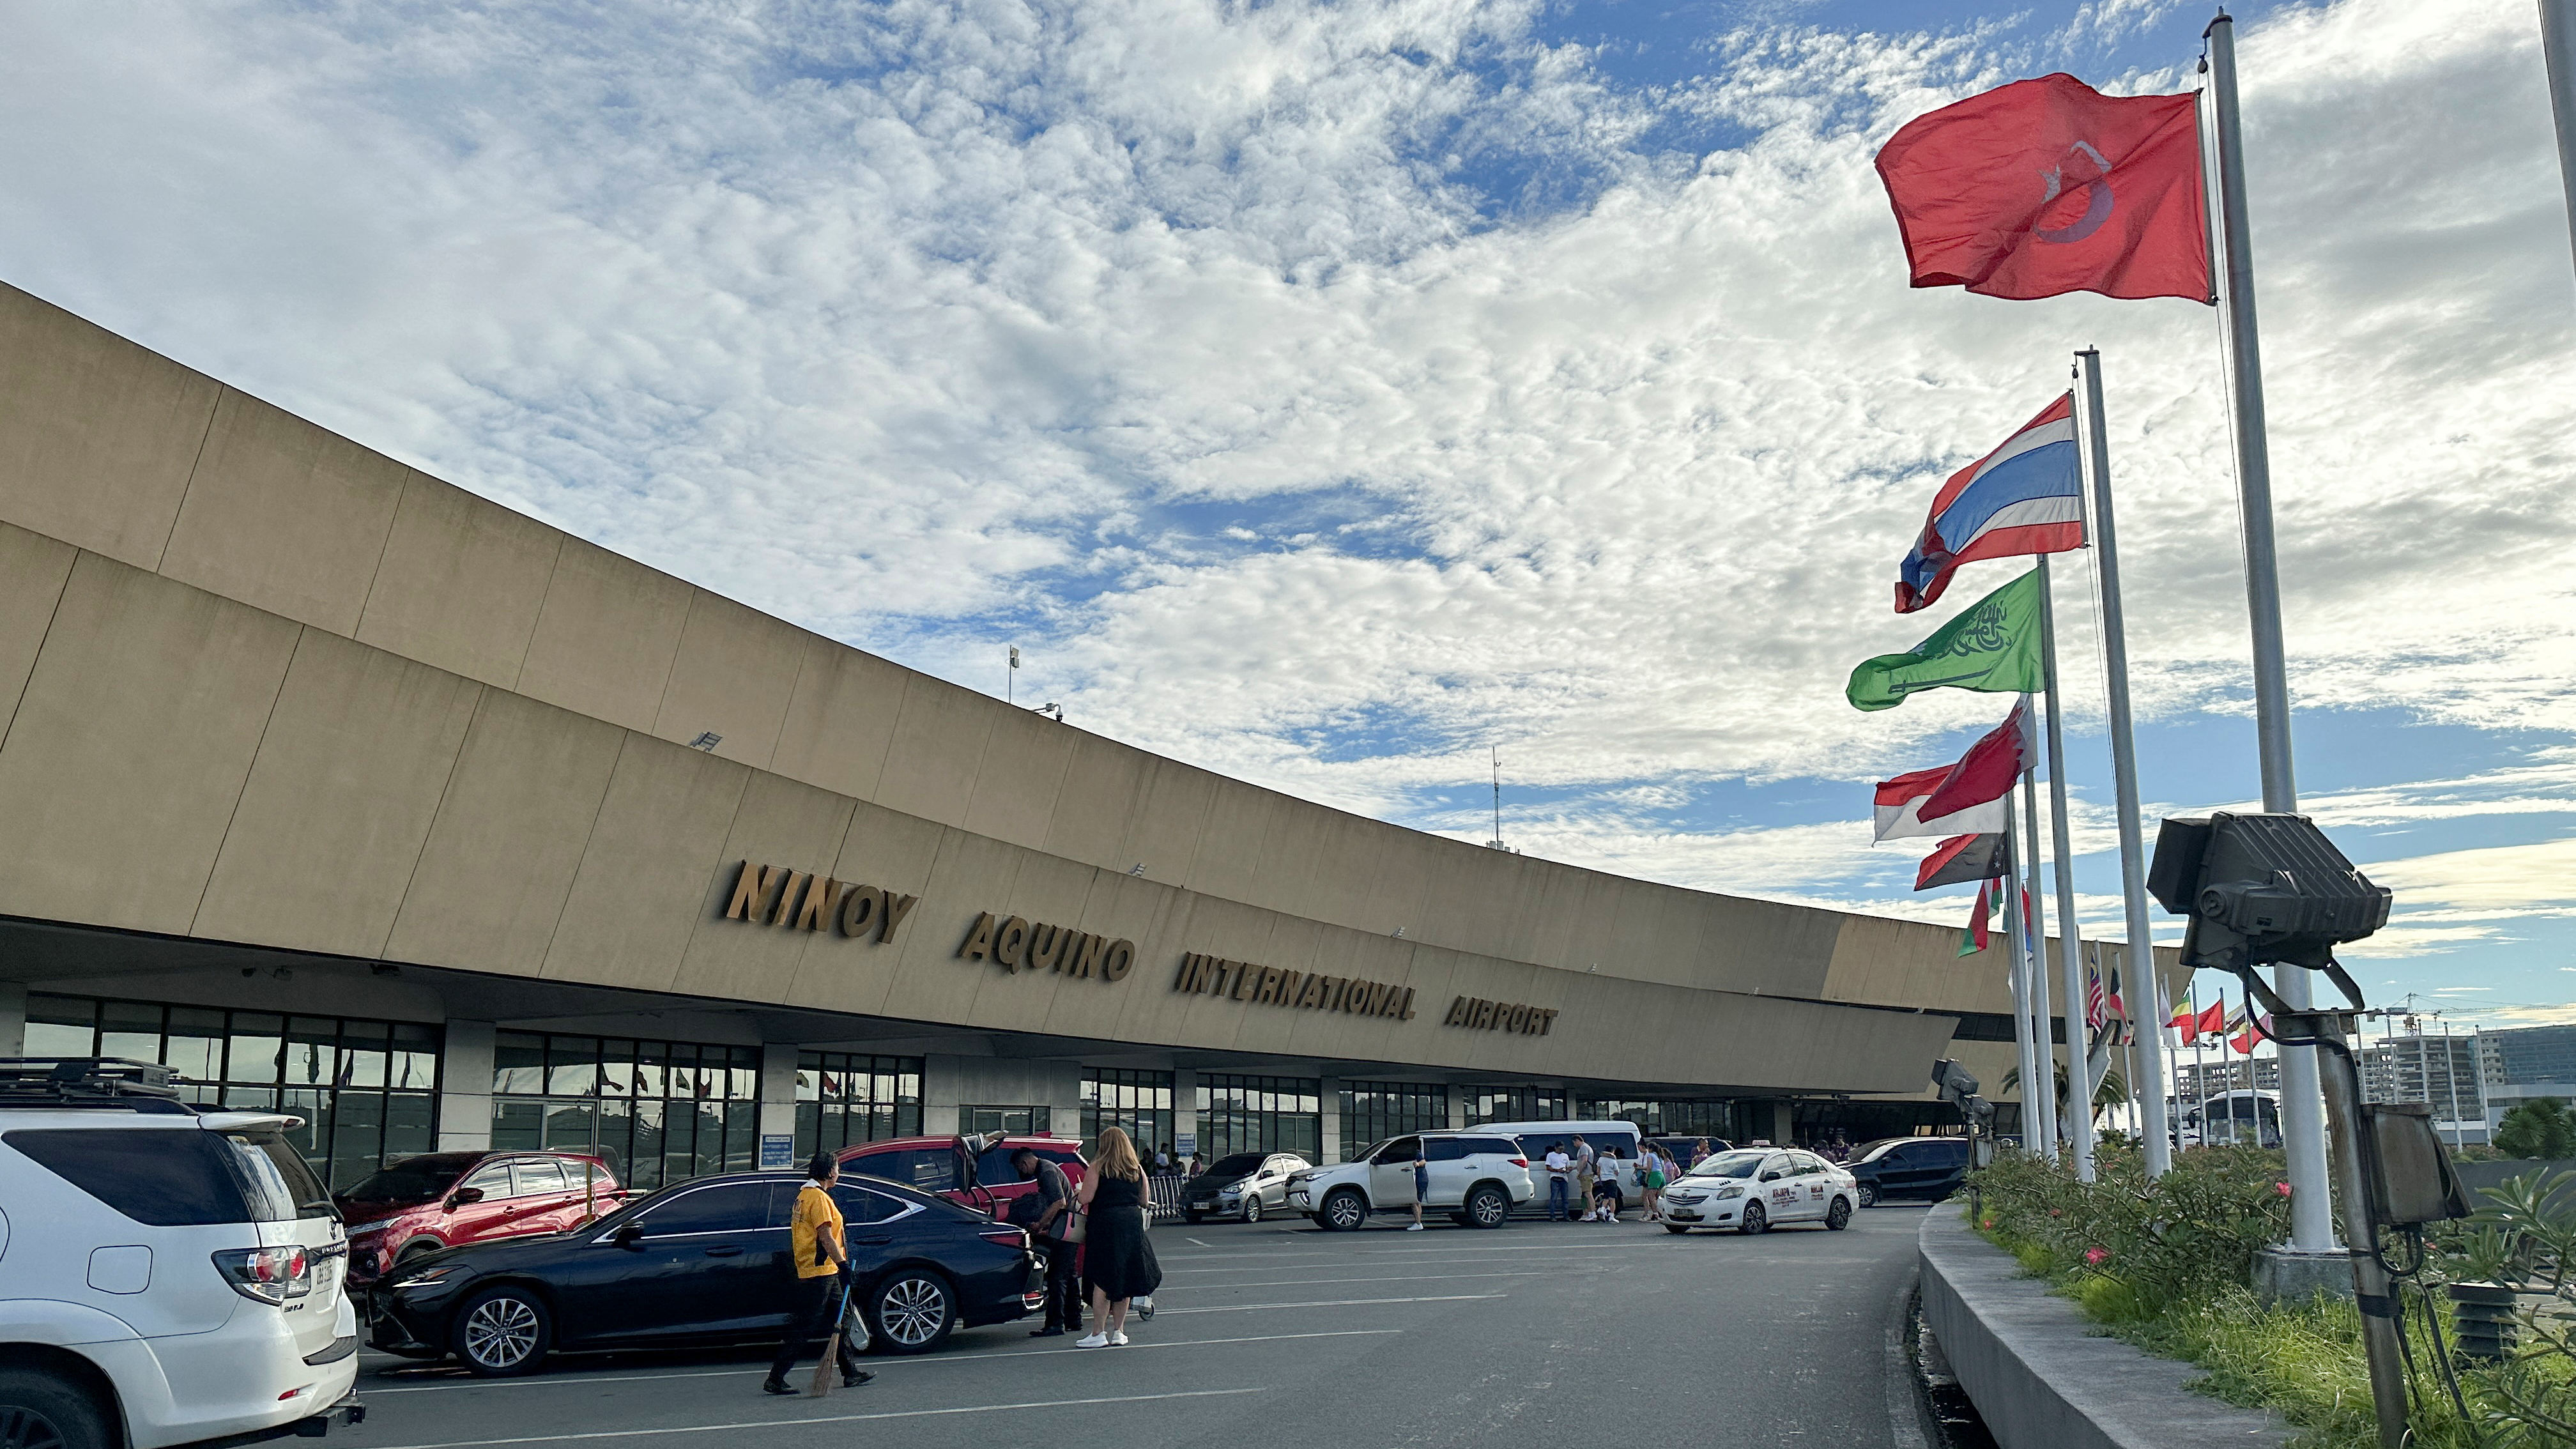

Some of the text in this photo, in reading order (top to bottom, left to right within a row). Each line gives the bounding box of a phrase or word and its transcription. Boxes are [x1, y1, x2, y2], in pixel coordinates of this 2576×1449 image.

[726, 860, 1559, 1036] NINOY AQUINO INTERNATIONAL AIRPORT
